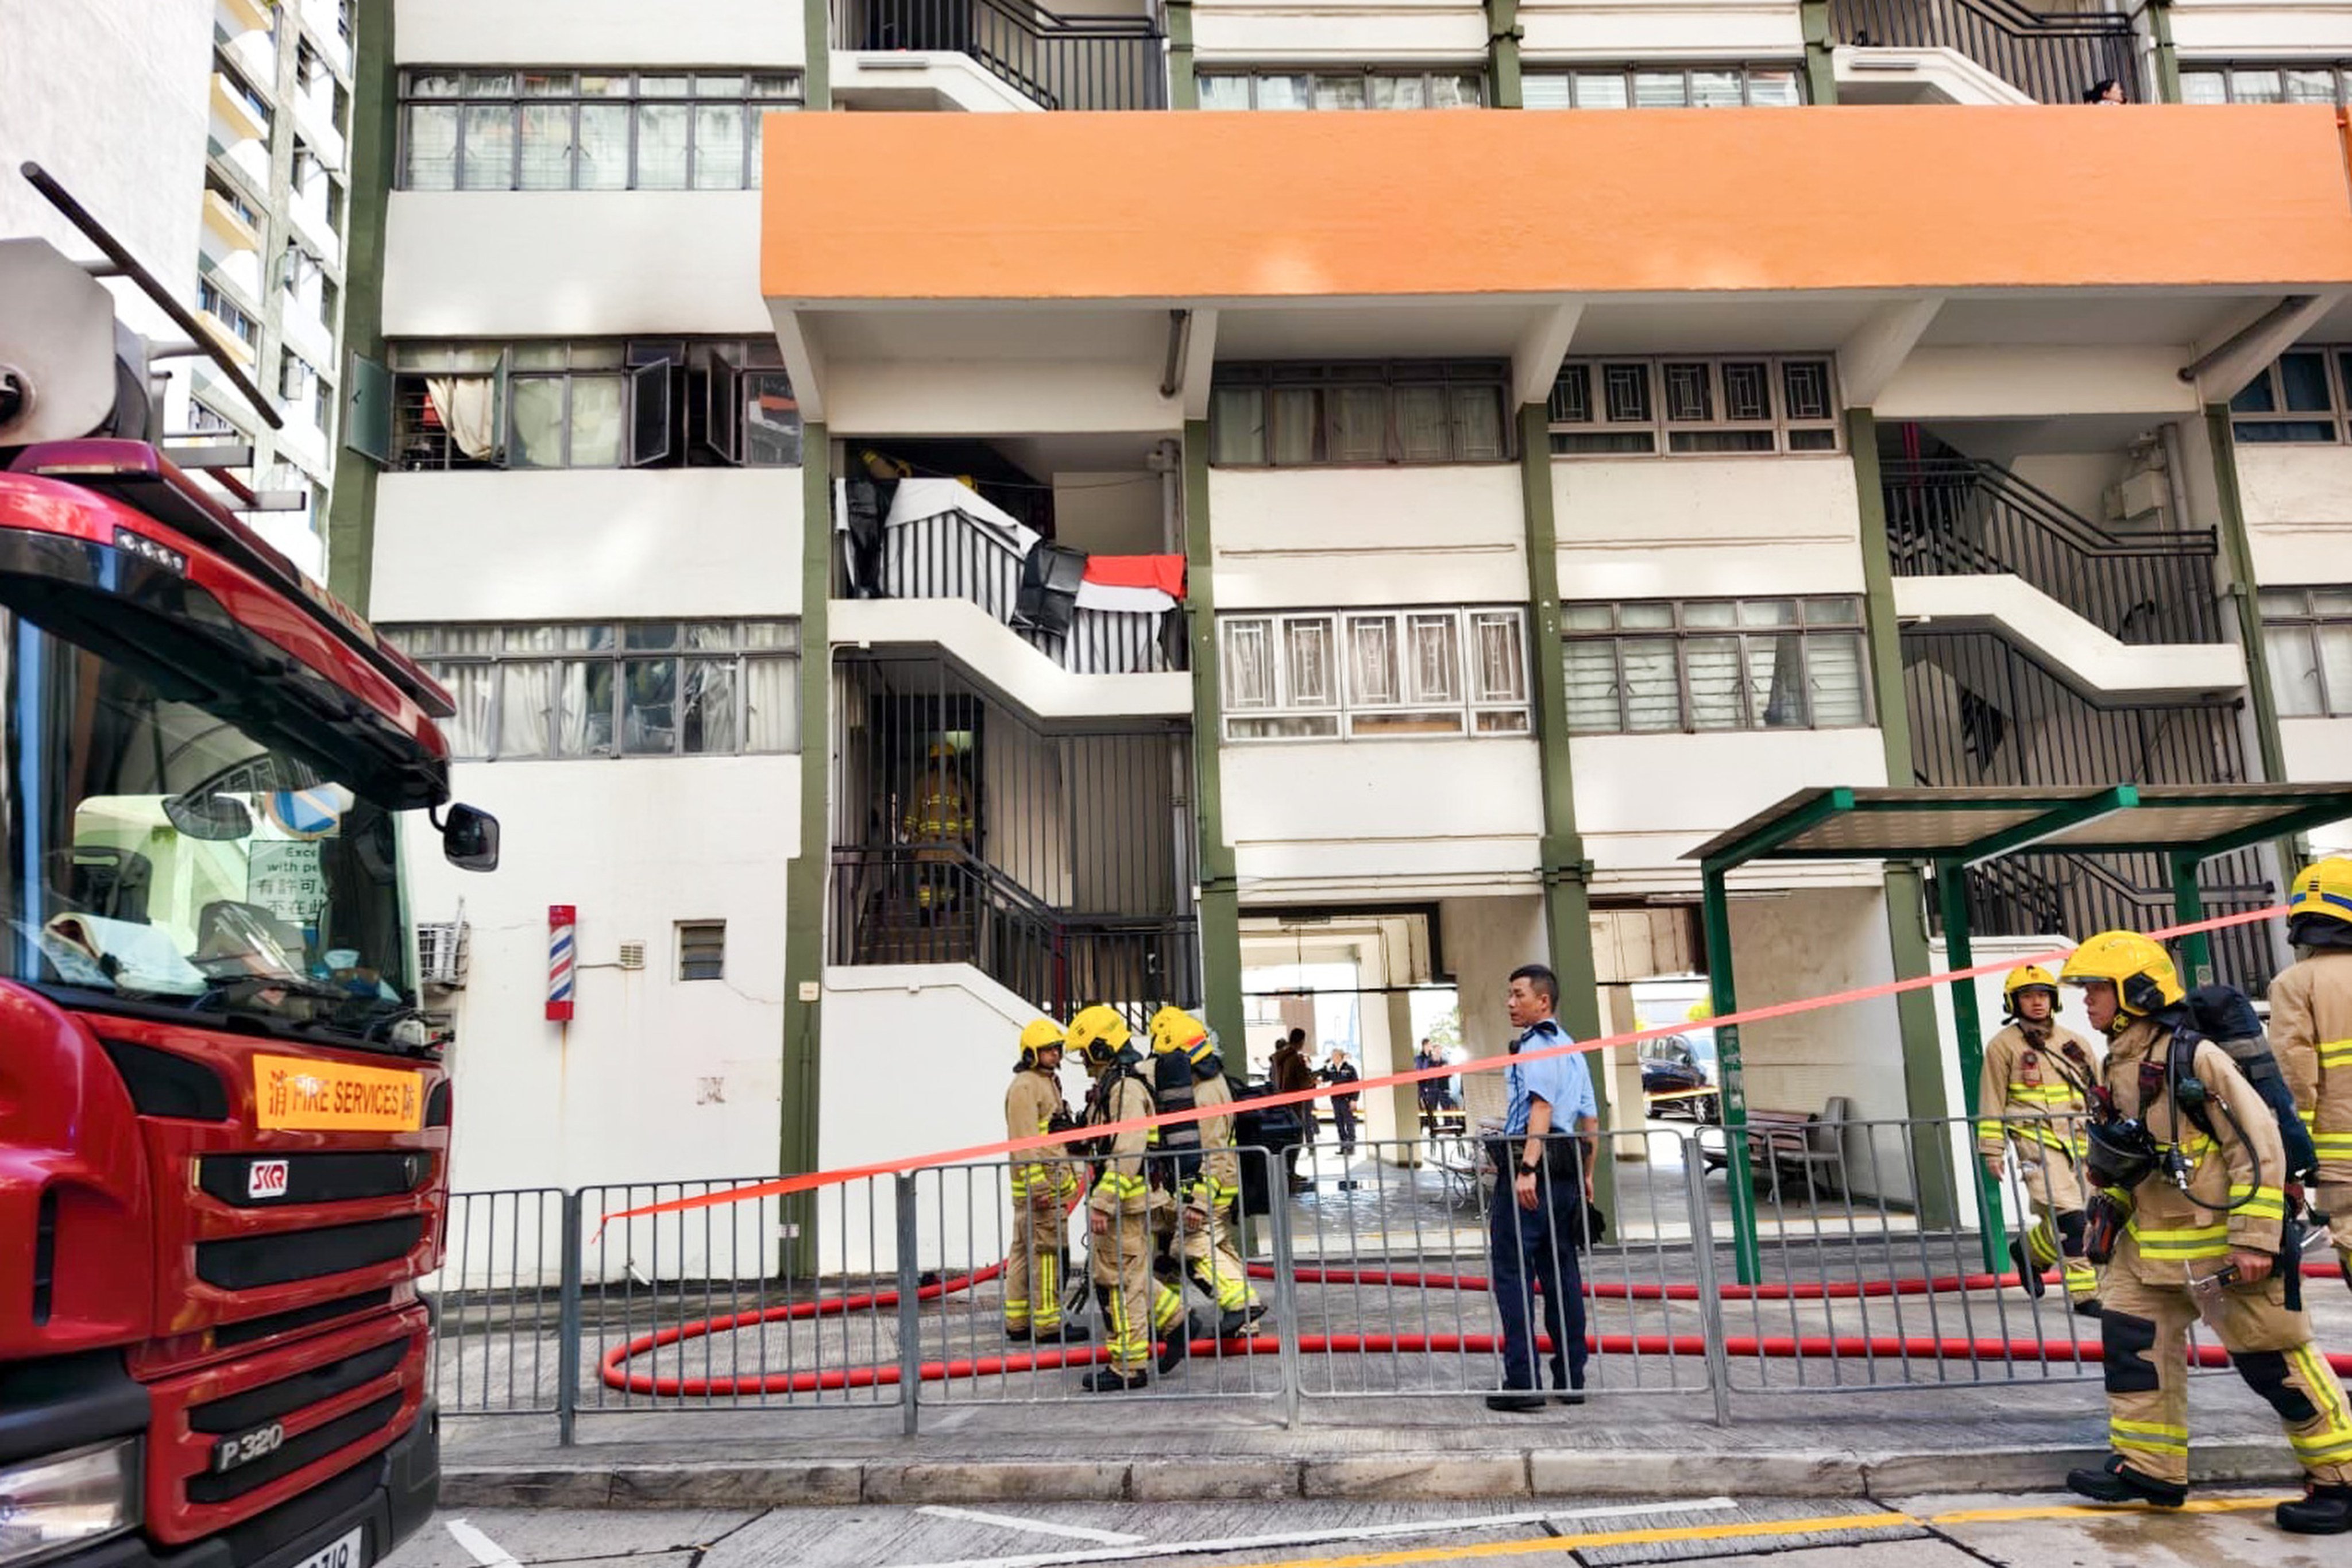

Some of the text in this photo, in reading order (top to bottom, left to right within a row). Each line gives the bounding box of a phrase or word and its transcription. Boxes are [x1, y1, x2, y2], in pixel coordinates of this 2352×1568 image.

[286, 847, 315, 857] Exc
[257, 878, 325, 895] 有許可
[267, 899, 325, 915] 不在此
[334, 1080, 399, 1116] SERVICES
[221, 1424, 283, 1470] P 320
